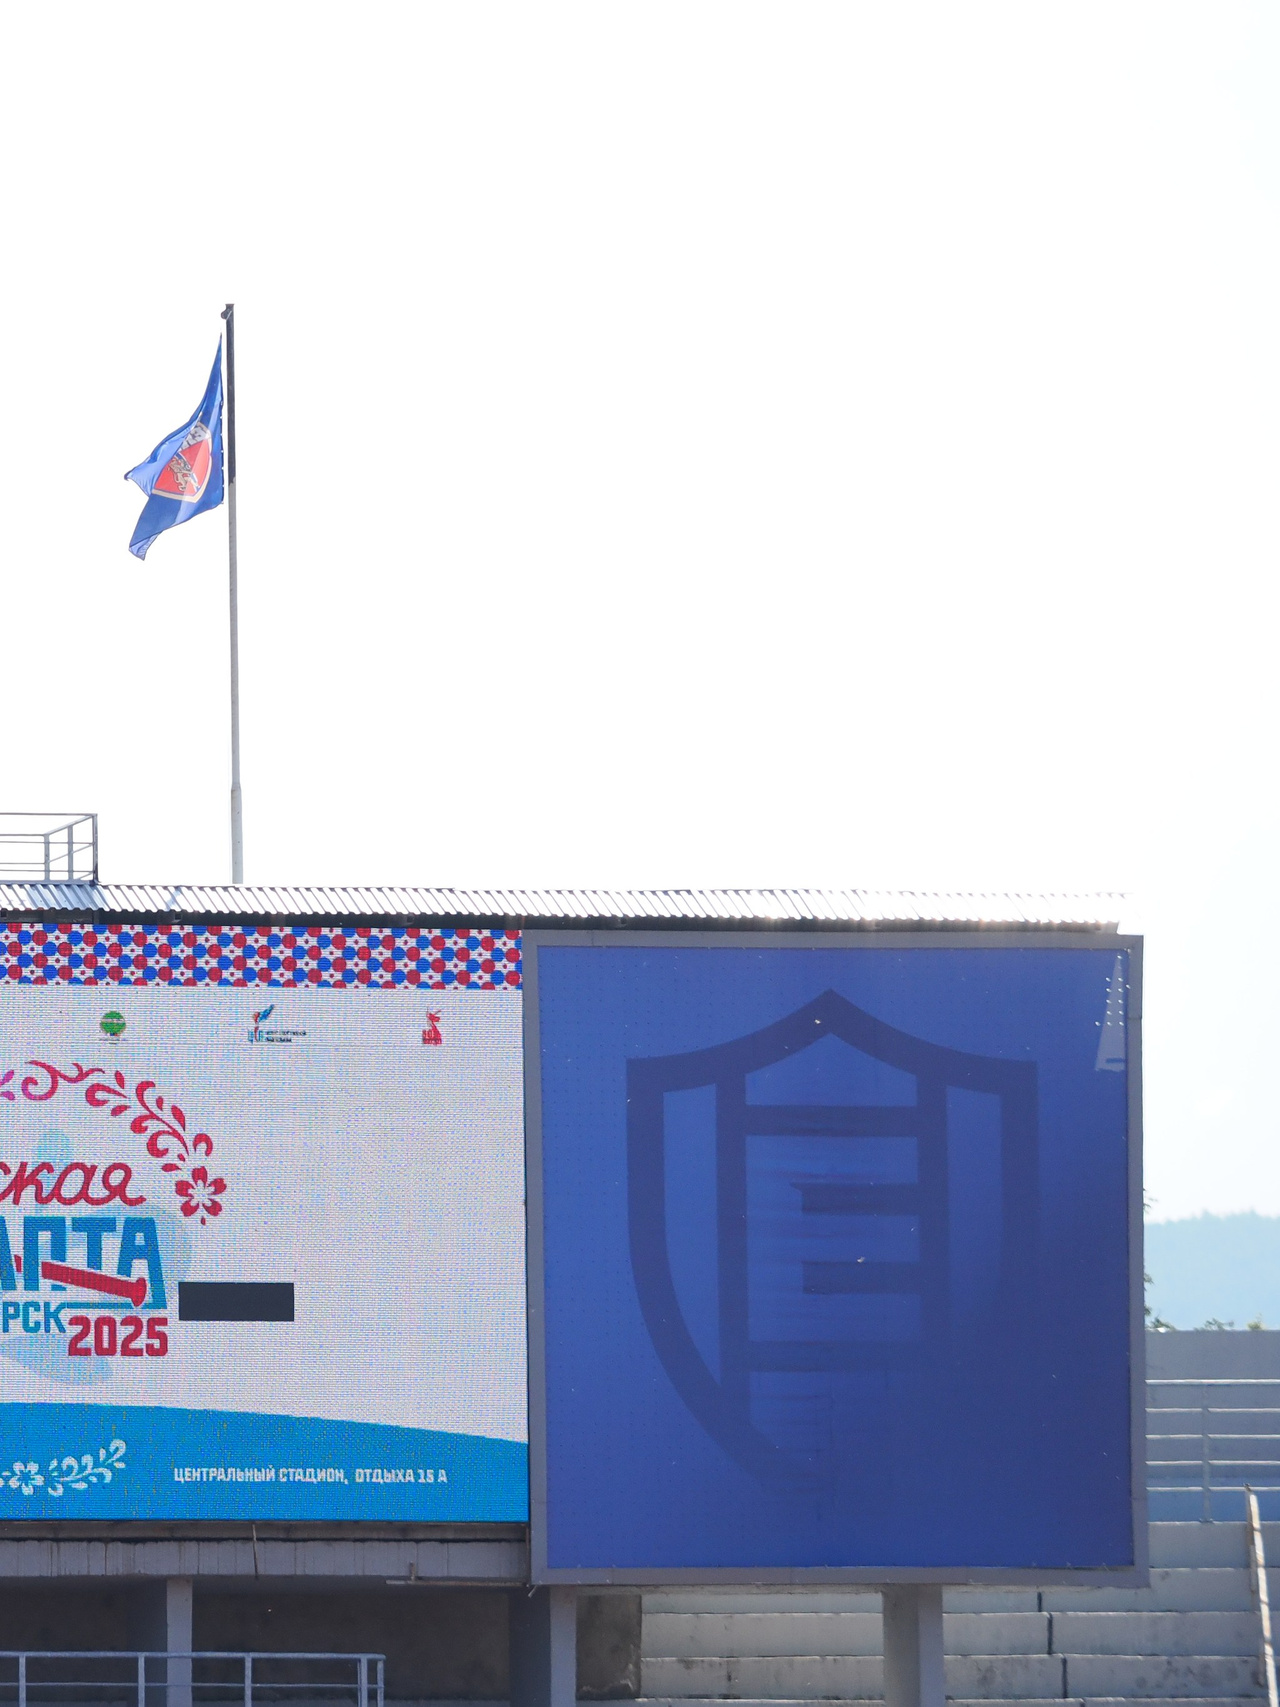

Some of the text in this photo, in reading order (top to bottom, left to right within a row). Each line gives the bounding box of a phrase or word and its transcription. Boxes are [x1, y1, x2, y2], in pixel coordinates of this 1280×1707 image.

[68, 1316, 168, 1356] 2025
[173, 1465, 275, 1483] ЦЕНТРАЛЬНЫЙ
[279, 1467, 348, 1485] СТАДИОН,
[354, 1468, 414, 1483] ОТДЫХА
[437, 1468, 448, 1483] А
